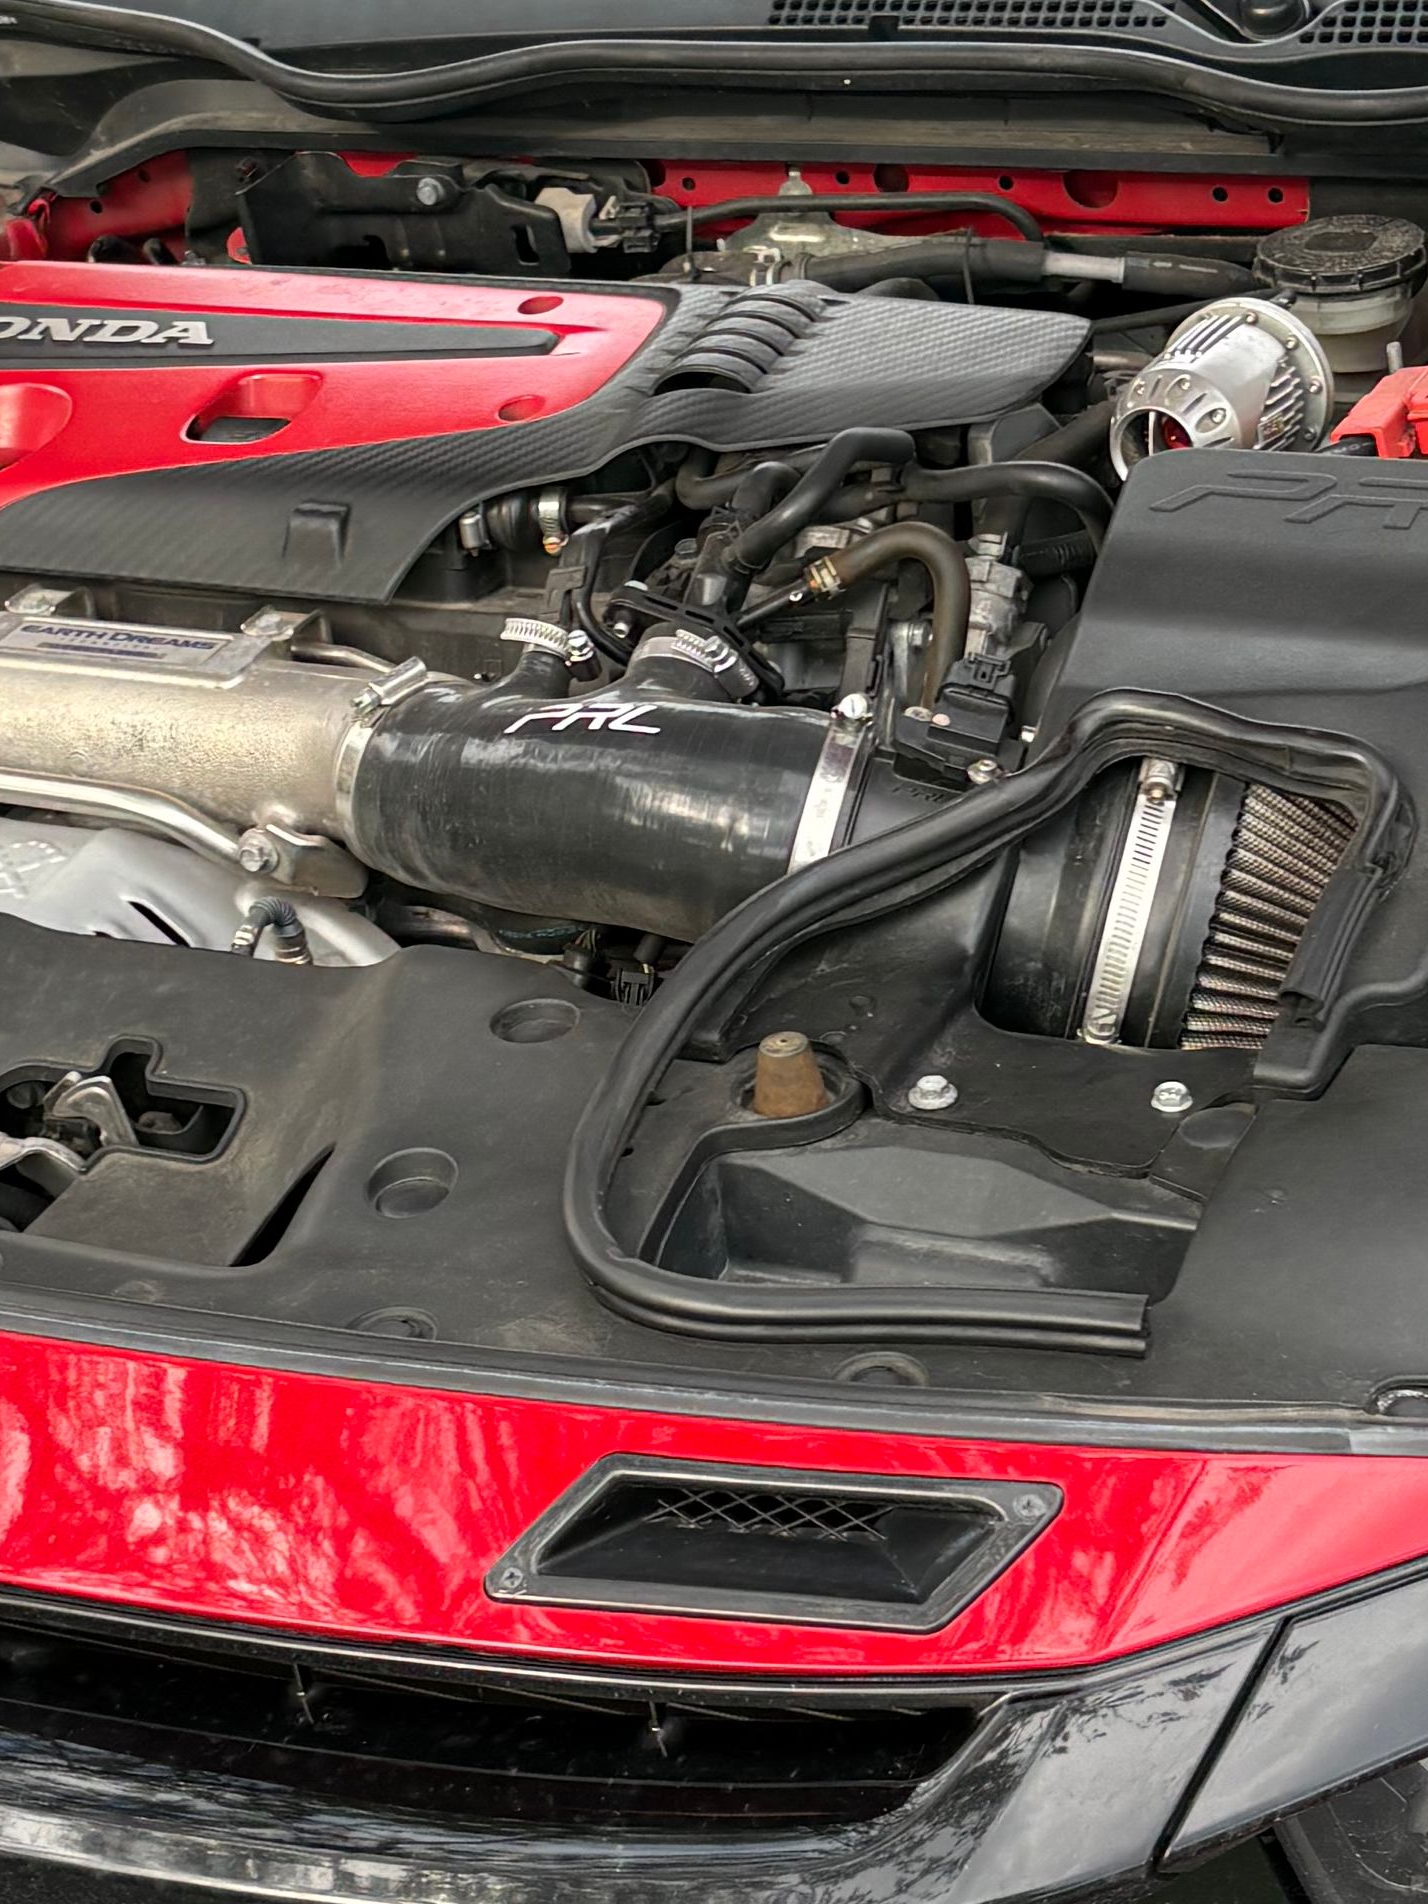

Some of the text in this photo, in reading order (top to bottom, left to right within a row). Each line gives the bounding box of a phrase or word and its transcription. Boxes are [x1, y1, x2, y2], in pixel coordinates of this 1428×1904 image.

[20, 624, 112, 640] EARTH
[110, 631, 222, 650] DREAMS
[502, 702, 662, 735] PRL
